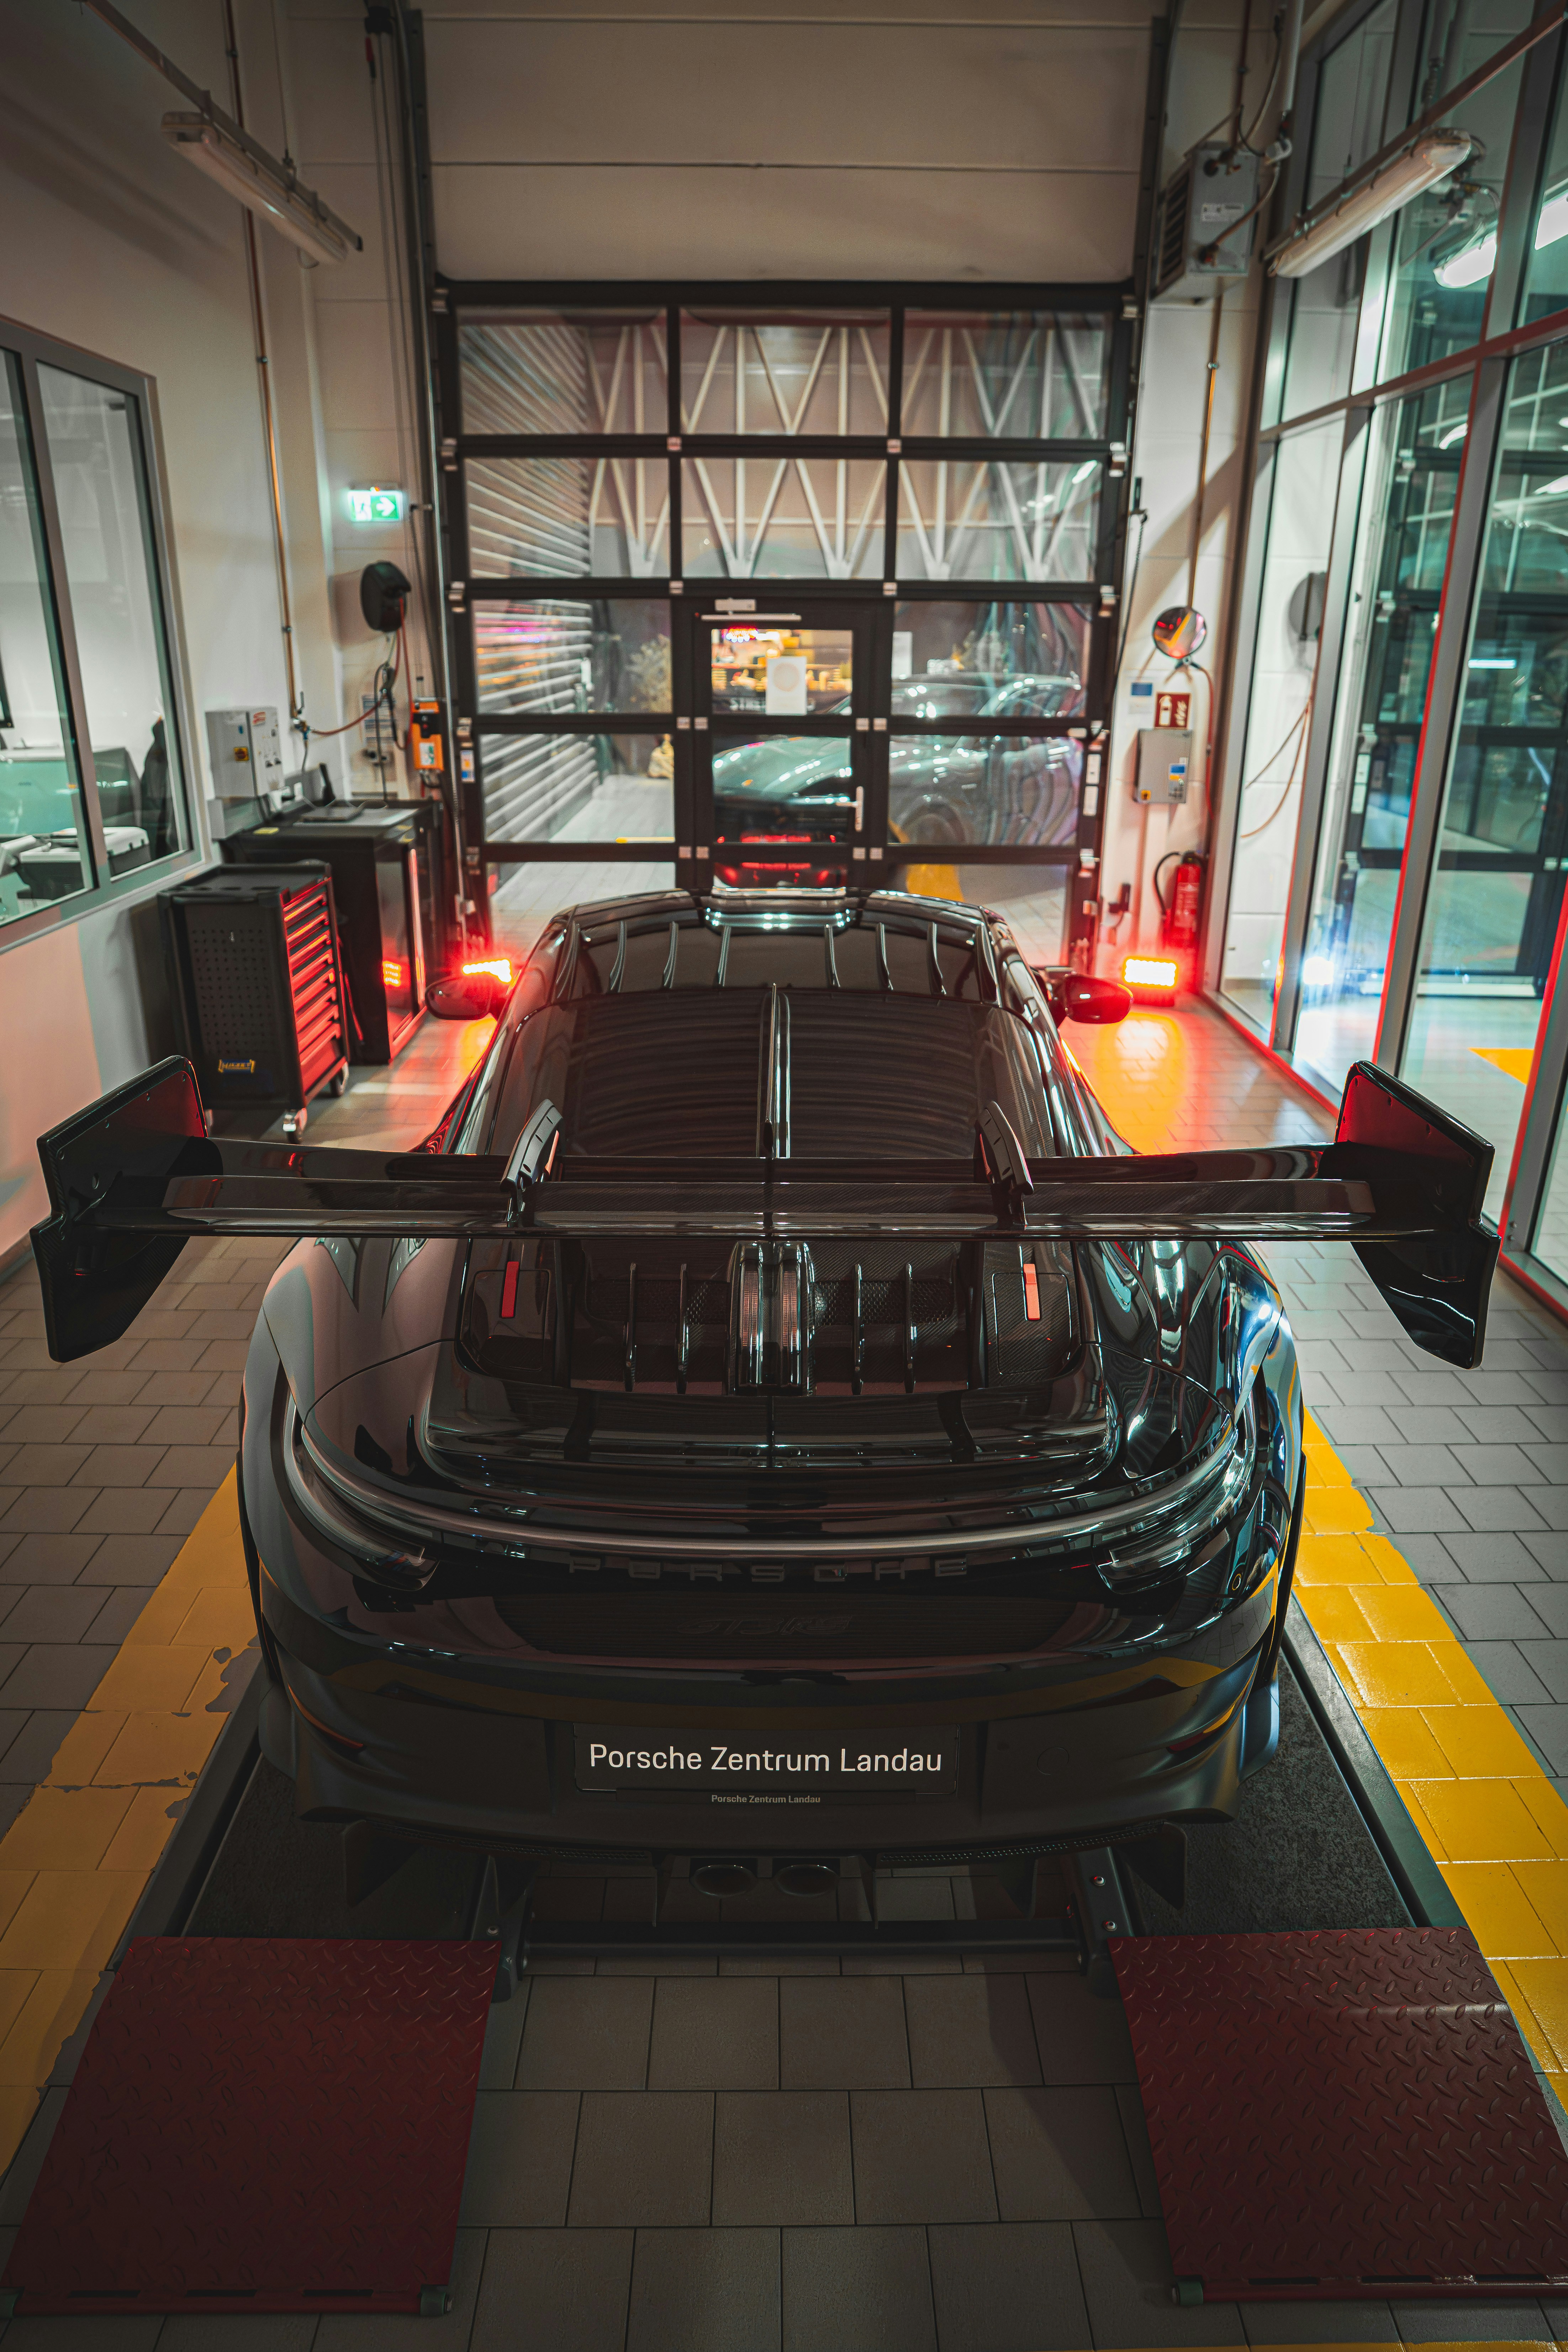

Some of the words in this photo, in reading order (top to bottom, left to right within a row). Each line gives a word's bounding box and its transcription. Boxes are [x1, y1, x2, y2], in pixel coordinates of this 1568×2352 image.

[569, 1555, 967, 1583] PORSCHE
[590, 1744, 702, 1770] Porsche
[711, 1746, 829, 1771] Zentrum
[841, 1748, 941, 1772] Landau
[711, 1794, 747, 1803] Porsche
[788, 1795, 820, 1803] Landau
